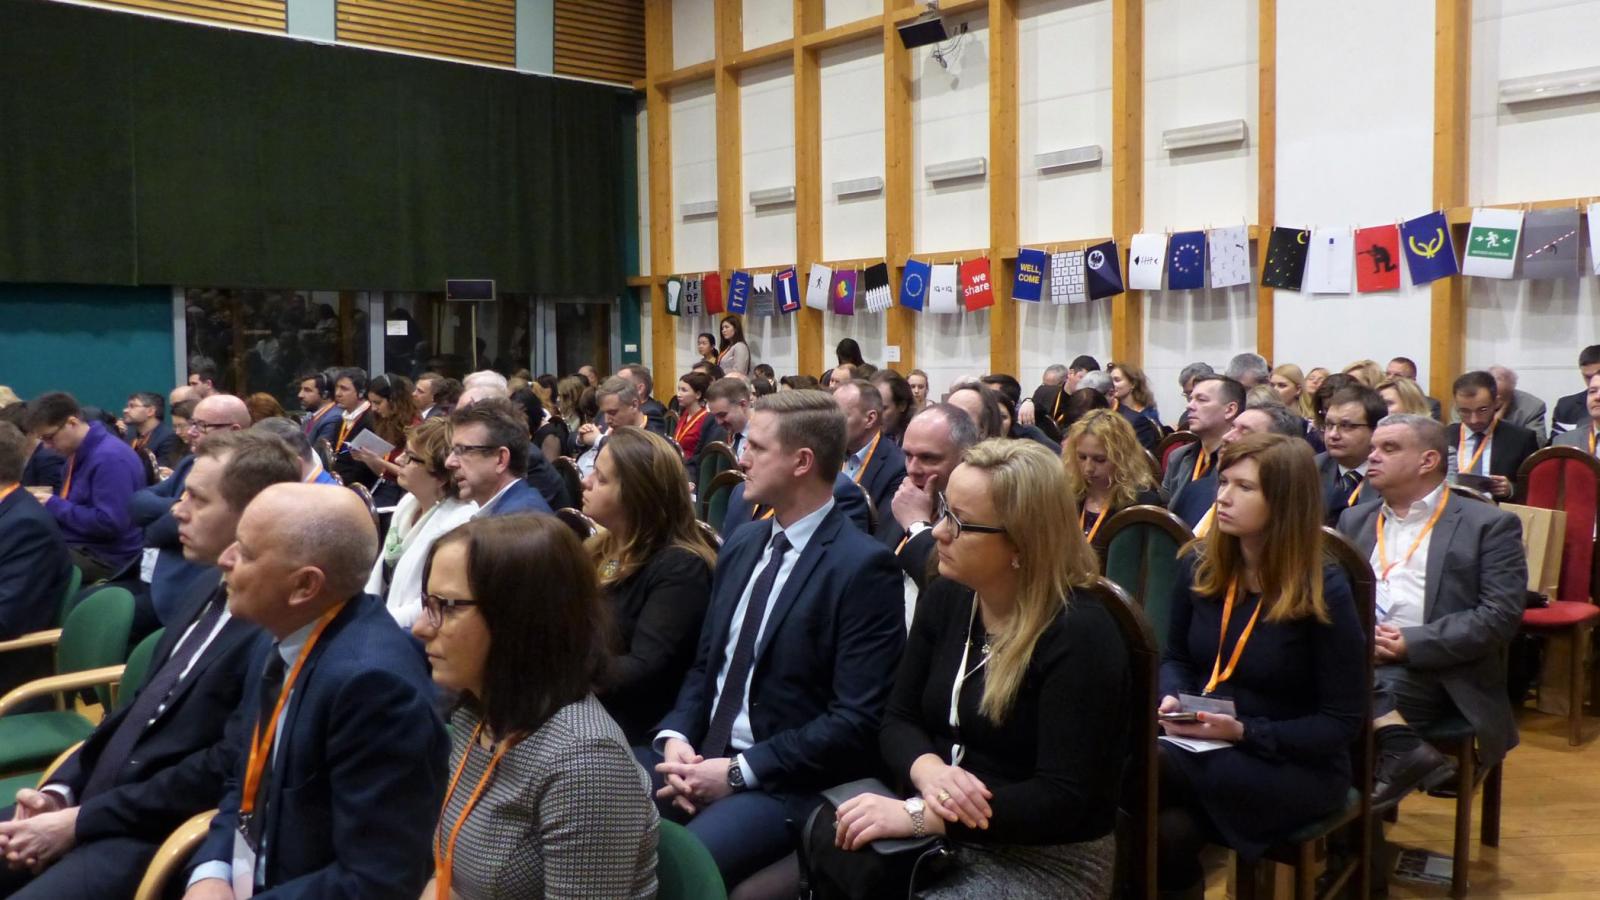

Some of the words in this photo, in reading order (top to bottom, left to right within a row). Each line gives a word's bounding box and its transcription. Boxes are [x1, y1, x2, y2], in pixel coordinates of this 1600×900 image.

[1020, 263, 1041, 276] WELL,
[972, 273, 986, 284] we
[1018, 273, 1040, 284] COME
[964, 282, 990, 297] share
